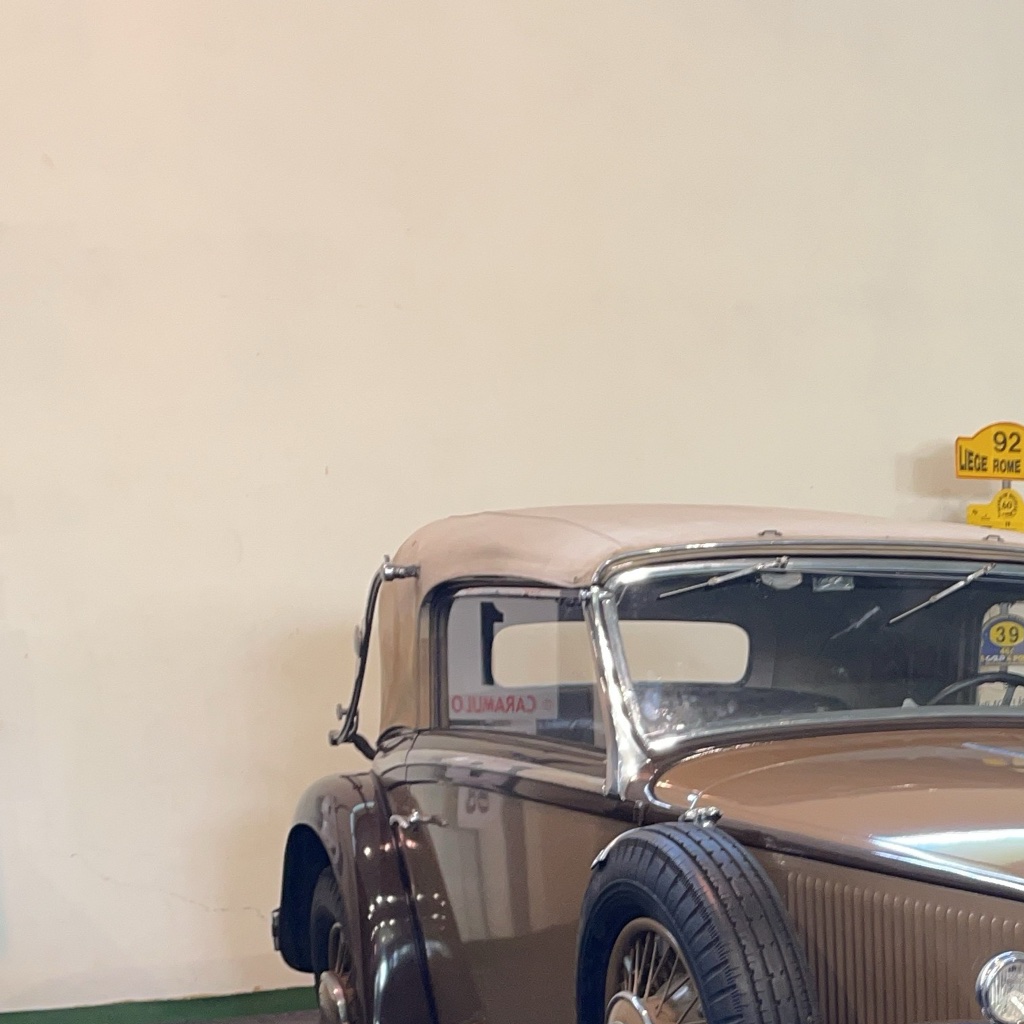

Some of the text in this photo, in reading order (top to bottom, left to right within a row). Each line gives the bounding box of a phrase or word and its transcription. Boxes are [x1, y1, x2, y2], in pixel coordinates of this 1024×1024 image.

[993, 431, 1021, 453] 92
[959, 445, 988, 471] LIEGE
[993, 458, 1021, 473] ROME
[995, 626, 1019, 643] 39
